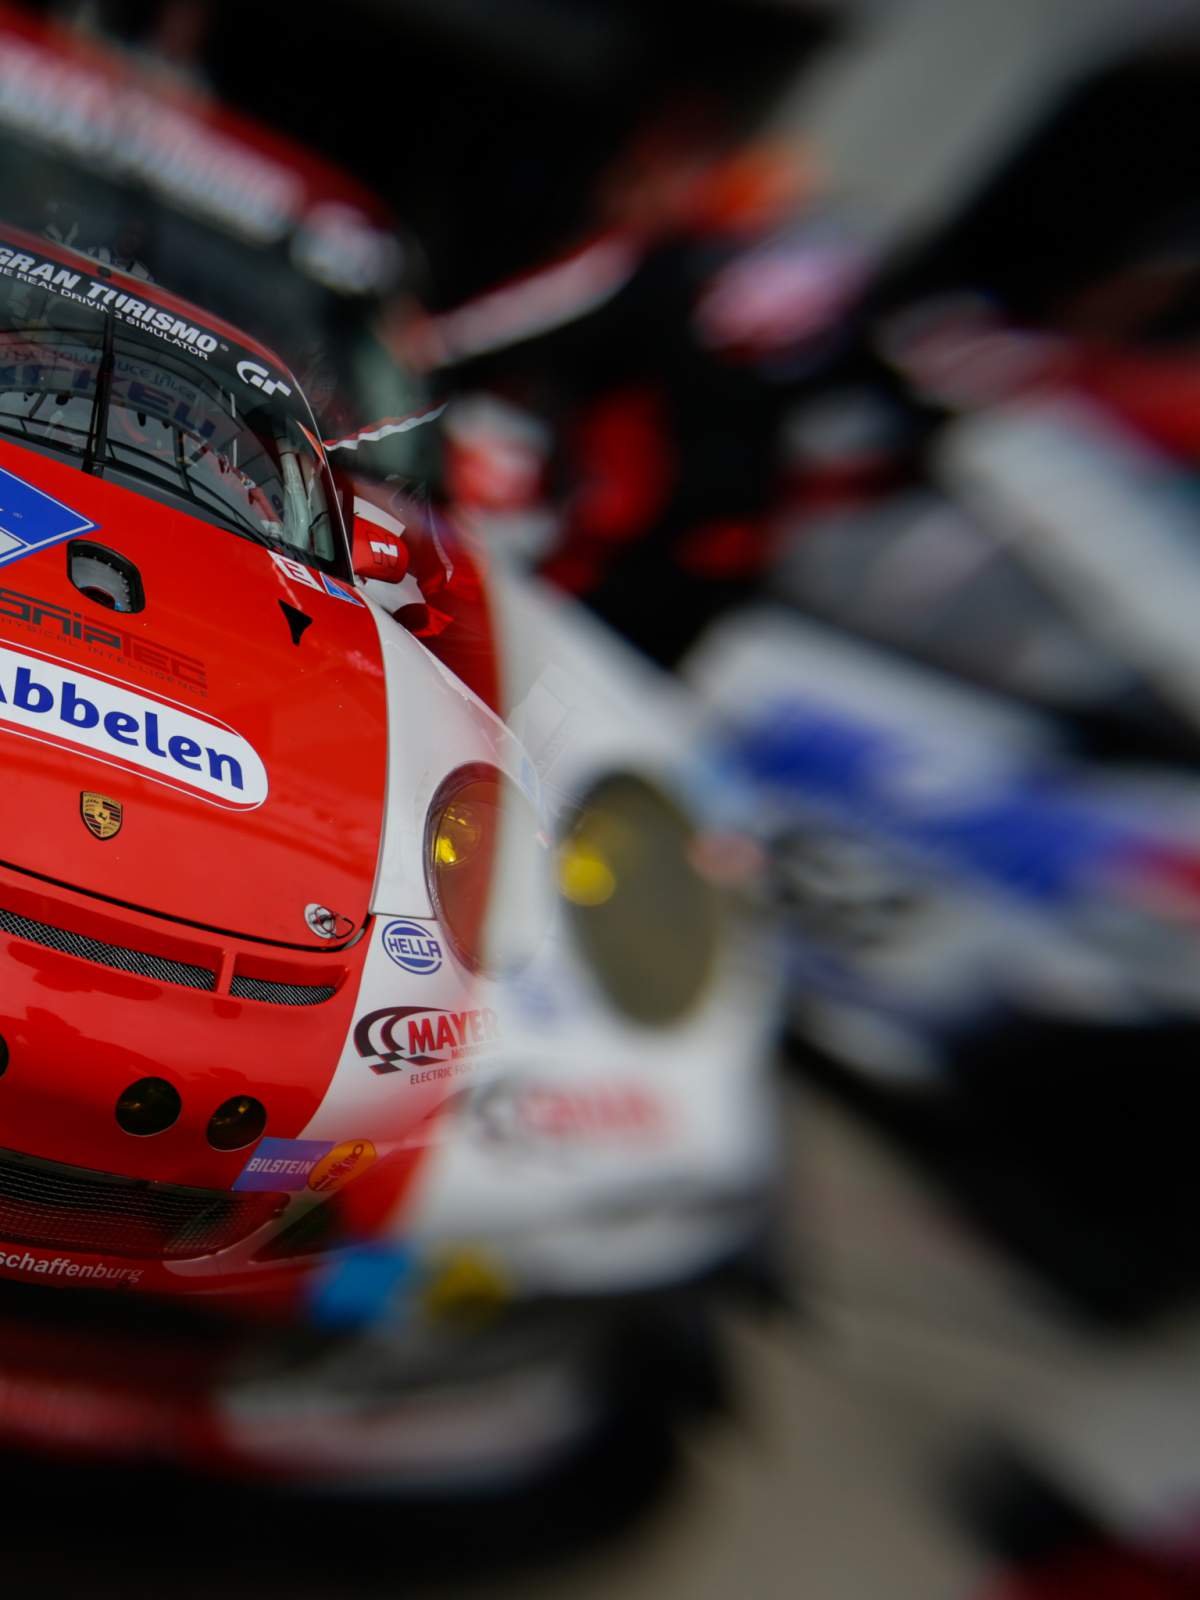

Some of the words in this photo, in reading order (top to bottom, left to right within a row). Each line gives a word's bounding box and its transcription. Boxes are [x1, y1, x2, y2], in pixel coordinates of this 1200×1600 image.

[16, 271, 58, 294] REAL
[125, 312, 209, 361] SIMULATOR
[84, 281, 218, 353] TURISMO
[389, 936, 443, 959] HELLA
[246, 1157, 315, 1175] BILSTEIN
